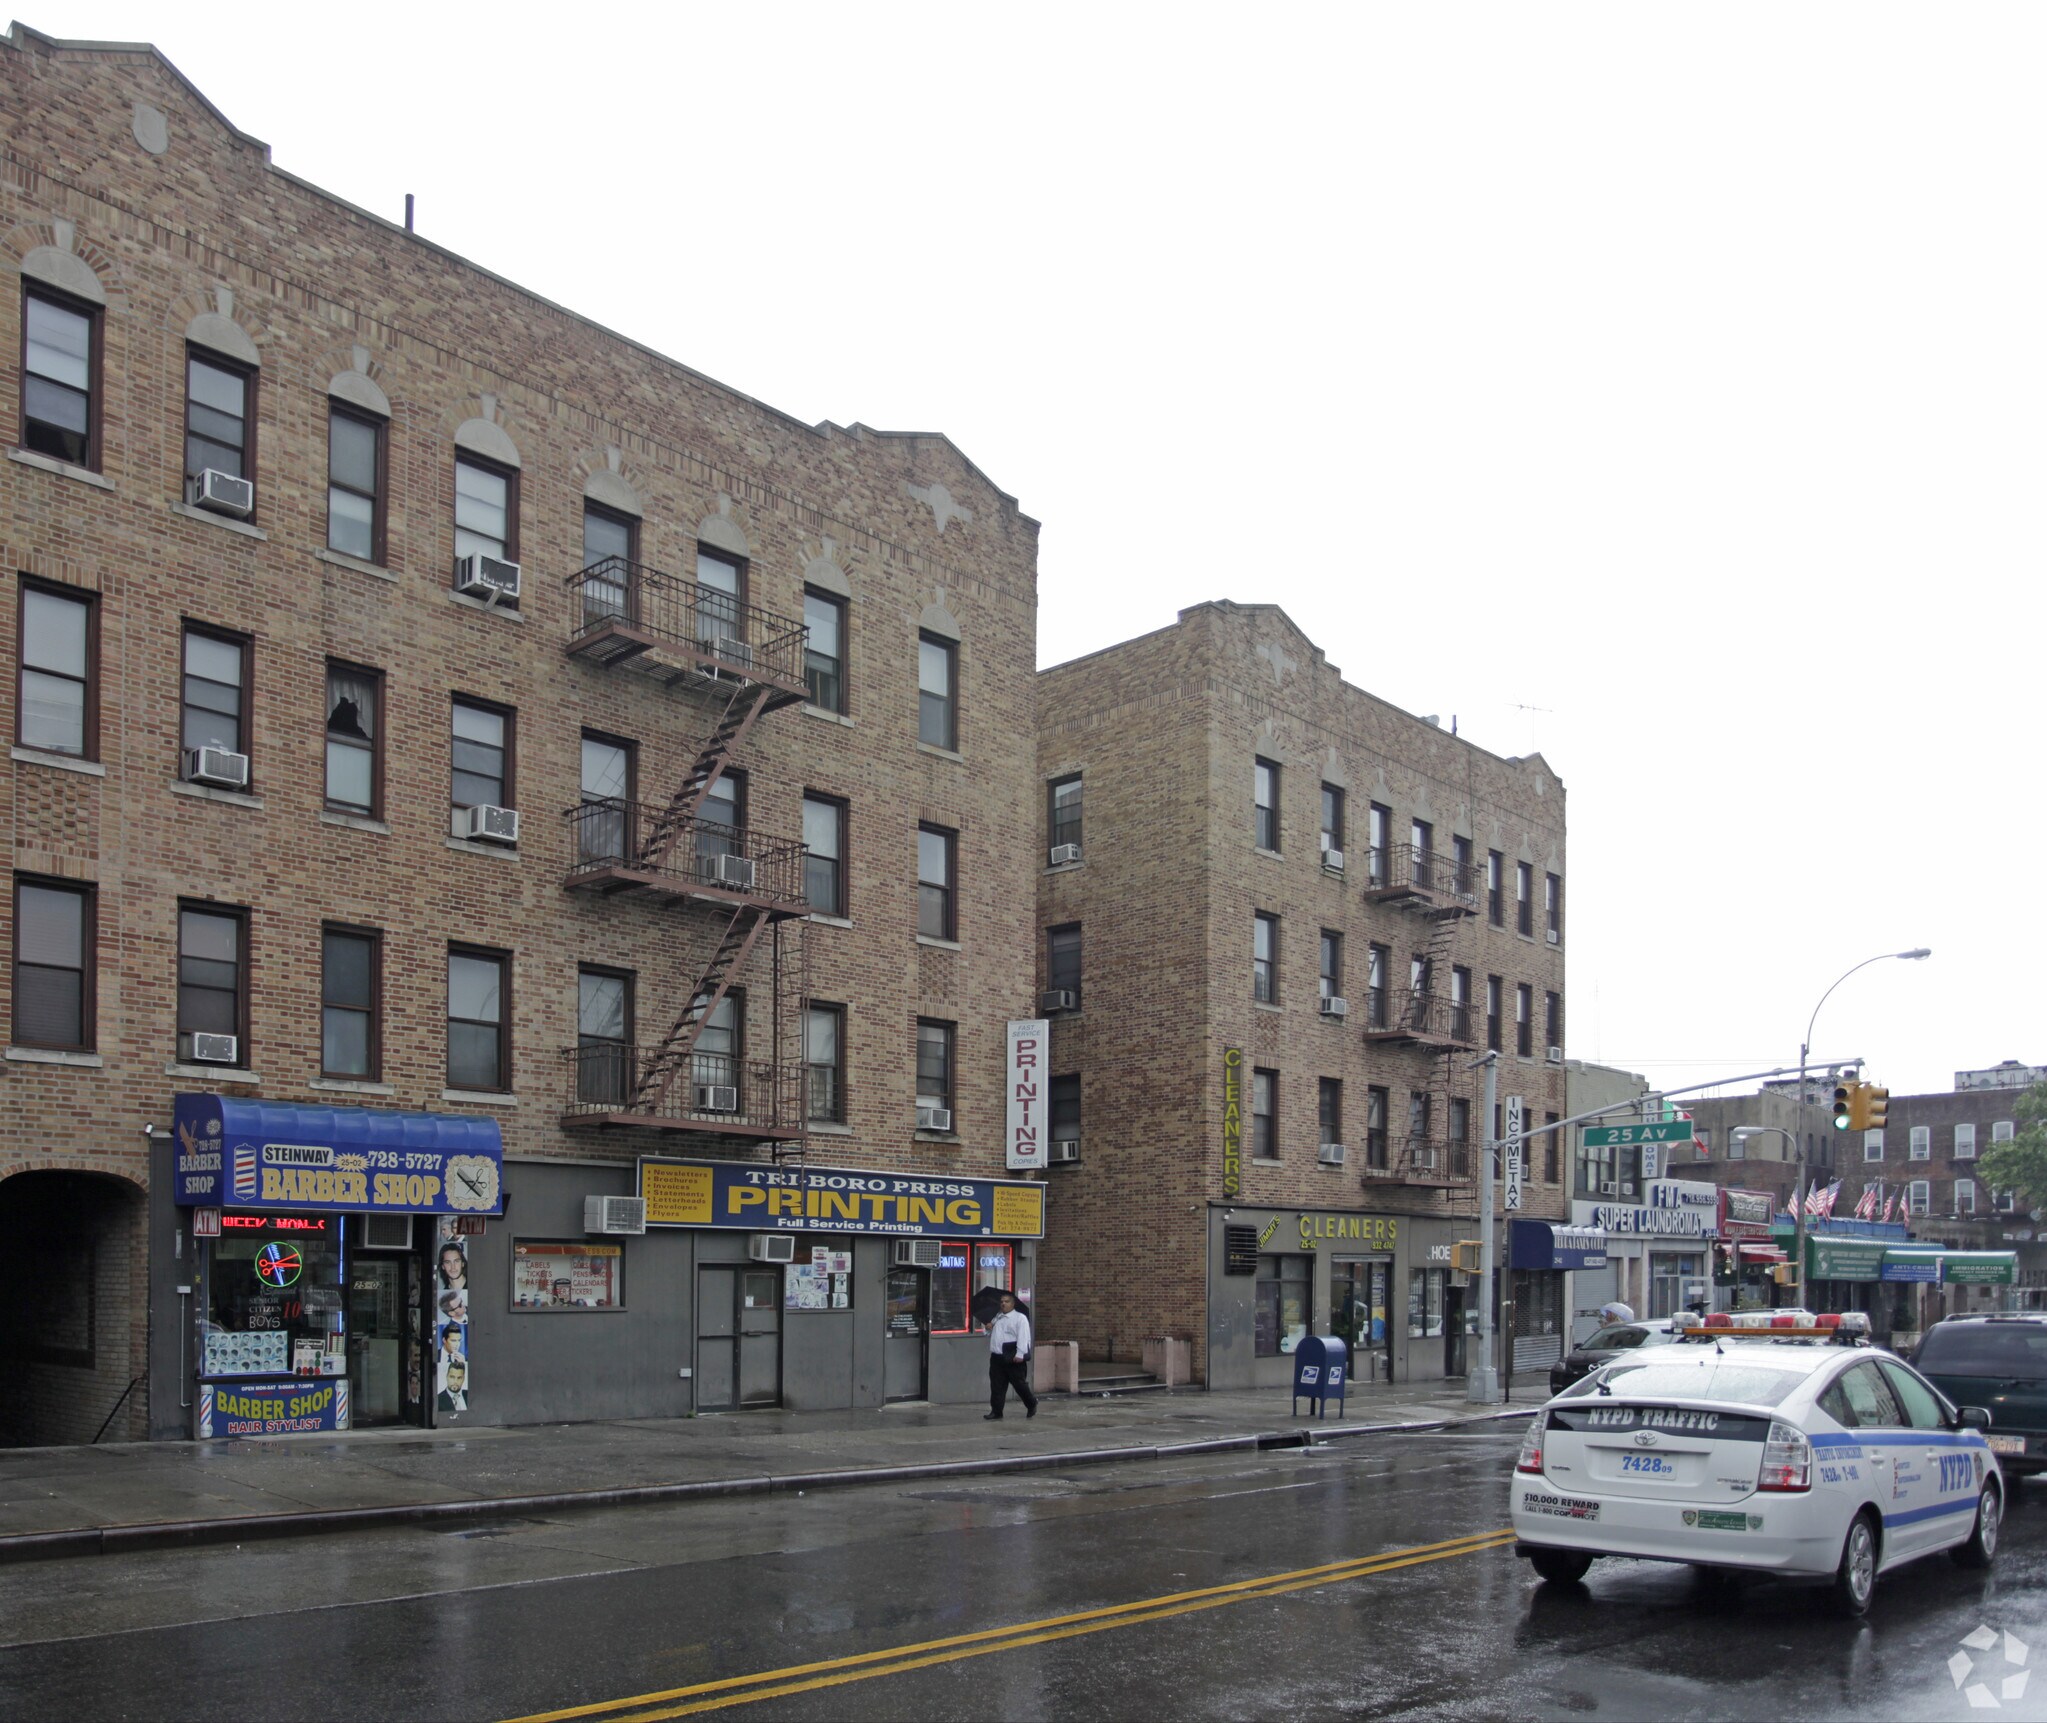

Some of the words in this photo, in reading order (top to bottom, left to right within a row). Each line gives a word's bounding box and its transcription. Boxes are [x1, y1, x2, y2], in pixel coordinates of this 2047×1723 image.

[1016, 1040, 1036, 1155] PRINTING
[1224, 1050, 1241, 1193] CLEANERS
[1608, 1128, 1632, 1142] 25
[180, 1153, 221, 1172] BARBER
[265, 1147, 330, 1164] STEINWAY
[341, 1159, 362, 1167] 25-02
[368, 1151, 442, 1170] 728-5727
[654, 1169, 708, 1178] Newsletters
[654, 1176, 698, 1184] Brochures
[185, 1176, 215, 1194] SHOP
[262, 1168, 368, 1203] BARBER
[373, 1173, 440, 1205] SHOP
[746, 1171, 886, 1191] TRI-BORO
[893, 1180, 974, 1197] PRESS
[652, 1210, 680, 1218] Flyers
[653, 1203, 697, 1211] Envelopes
[728, 1186, 981, 1225] PRINTING
[196, 1210, 218, 1233] ATM
[460, 1218, 483, 1233] ATM
[778, 1218, 803, 1227] Full
[810, 1219, 864, 1230] Service
[869, 1222, 923, 1233] Printing
[1300, 1216, 1397, 1239] CLEANERS
[1597, 1207, 1635, 1232] SUPER
[1639, 1209, 1703, 1234] LAUNDROMAT
[355, 1281, 382, 1289] 25-02
[249, 1316, 280, 1328] BOYS
[217, 1390, 284, 1420] BARBER
[290, 1387, 333, 1417] SHOP
[228, 1421, 262, 1433] HAIR
[266, 1418, 322, 1432] STYLIST
[1588, 1408, 1634, 1425] NYPD
[1641, 1409, 1719, 1431] TRAFFIC
[1939, 1453, 1972, 1492] NYPD
[1525, 1493, 1558, 1505] $10,000
[1561, 1499, 1599, 1510] REWARD
